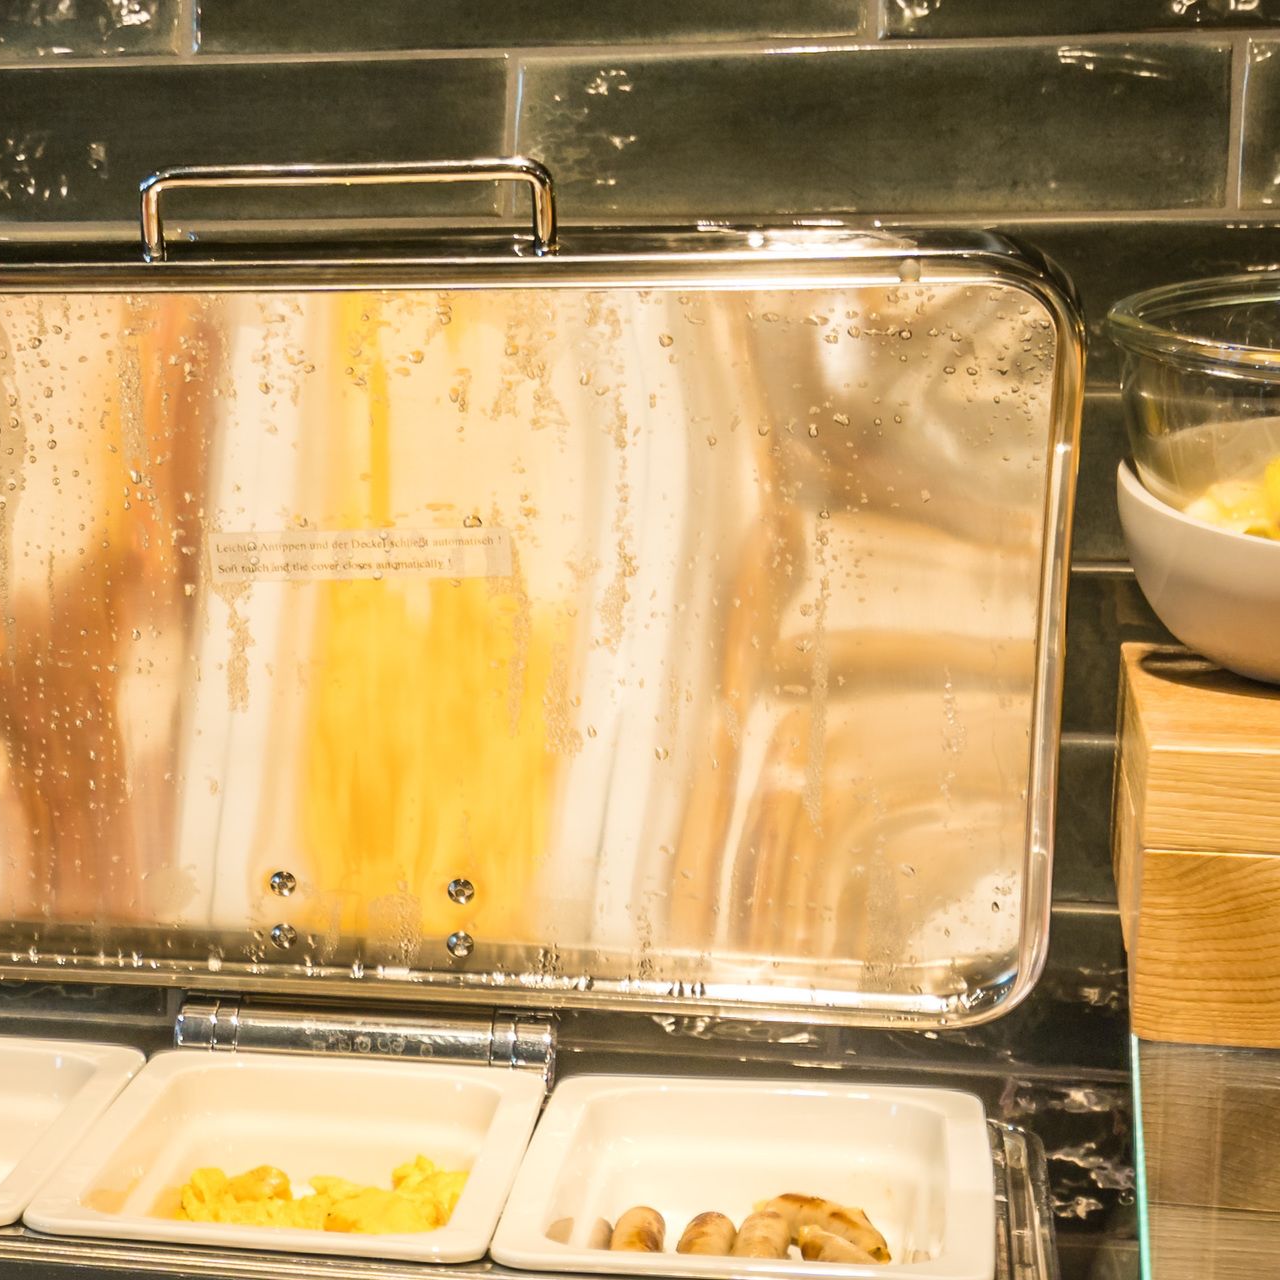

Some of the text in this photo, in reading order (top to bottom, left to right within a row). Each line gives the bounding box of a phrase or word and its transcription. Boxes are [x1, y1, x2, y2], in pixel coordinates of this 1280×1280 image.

[216, 542, 257, 553] Leicht
[260, 542, 307, 553] Antippen
[309, 541, 329, 550] und
[332, 540, 348, 550] der
[351, 538, 387, 549] Deckel
[432, 536, 494, 547] automatisch
[218, 563, 238, 574] Soft
[272, 562, 290, 573] and
[292, 562, 310, 571] the
[311, 562, 338, 571] cover
